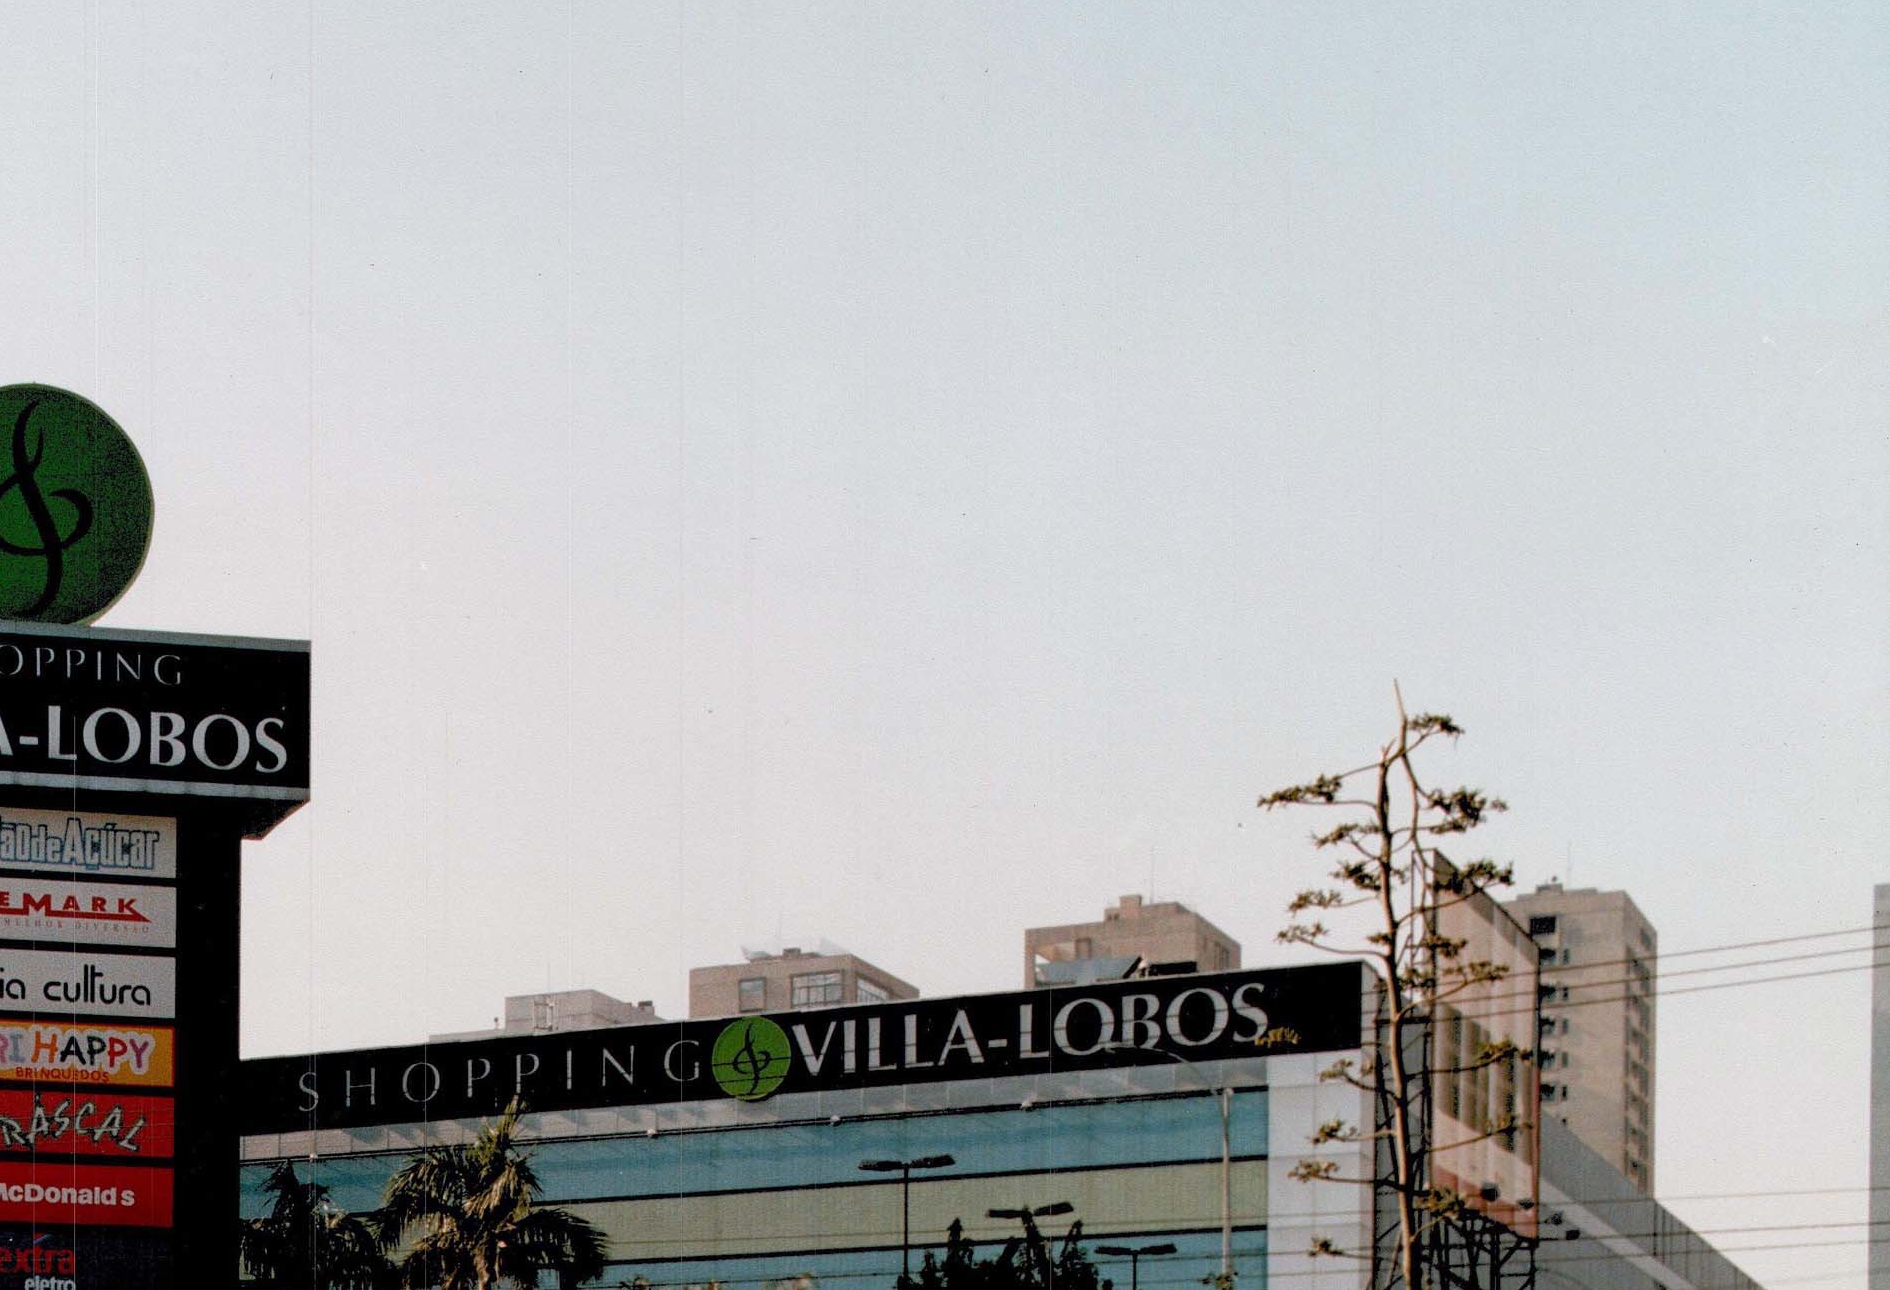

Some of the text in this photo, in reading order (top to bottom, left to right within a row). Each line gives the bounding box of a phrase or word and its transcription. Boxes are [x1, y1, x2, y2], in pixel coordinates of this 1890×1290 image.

[43, 964, 151, 1006] cultura
[790, 982, 1270, 1076] VILLA-LOBOS
[15, 1067, 110, 1082] BRINQUEDOS
[298, 1039, 701, 1112] SHOPPING
